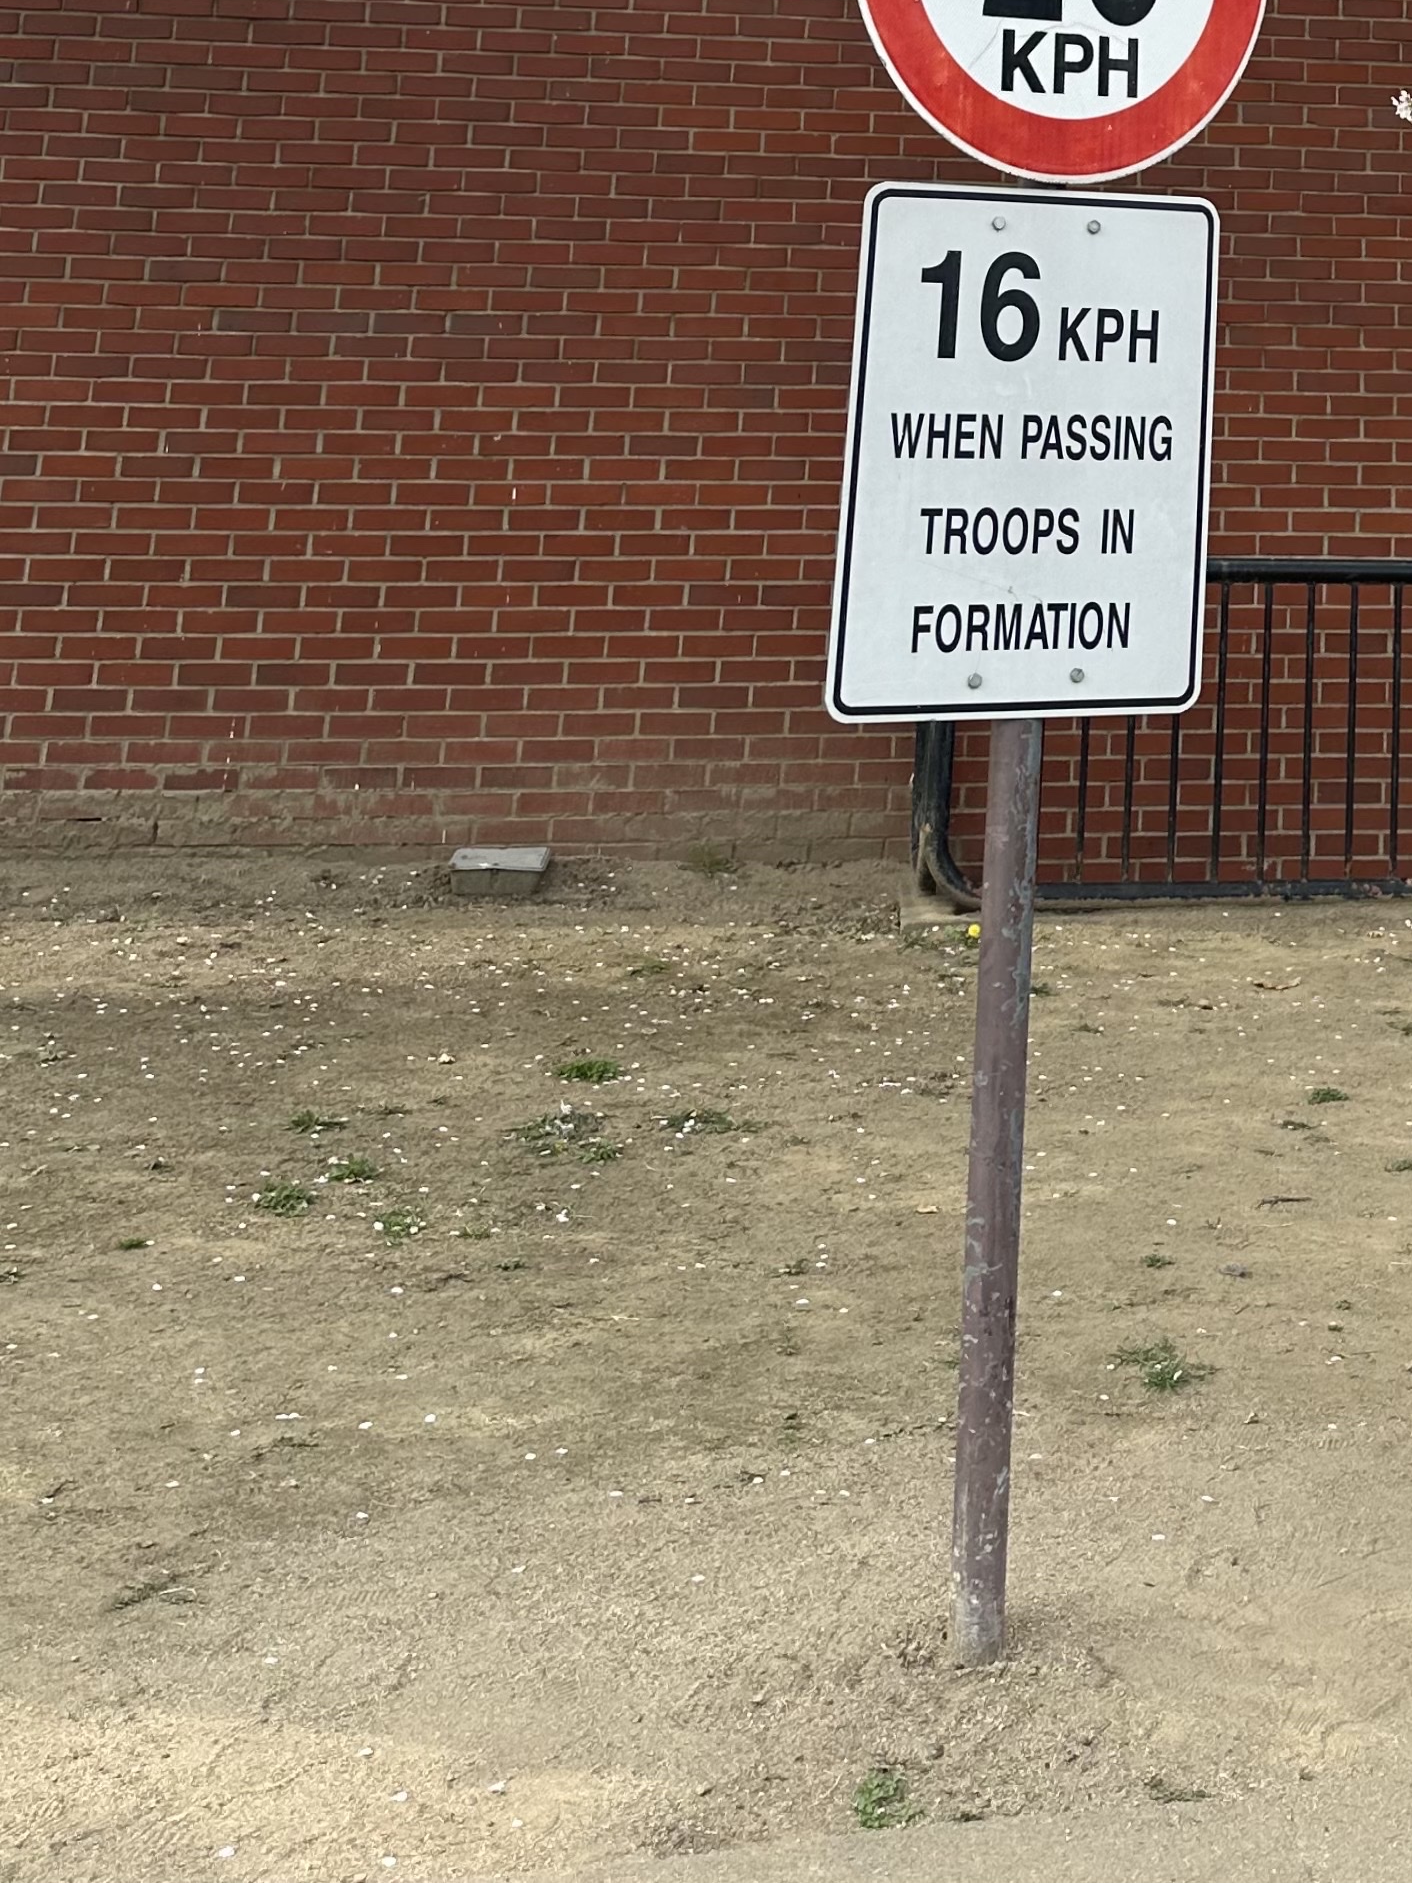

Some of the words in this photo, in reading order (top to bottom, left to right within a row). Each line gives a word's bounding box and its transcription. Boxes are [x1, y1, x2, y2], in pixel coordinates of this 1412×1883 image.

[1000, 28, 1139, 98] KPH
[921, 250, 1041, 362] 16
[1058, 307, 1160, 364] KPH
[890, 412, 1004, 460] WHEN
[1020, 414, 1173, 462] PASSING
[920, 507, 1080, 556] TROOPS
[1101, 508, 1135, 555] IN
[911, 601, 1131, 654] FORMATION
